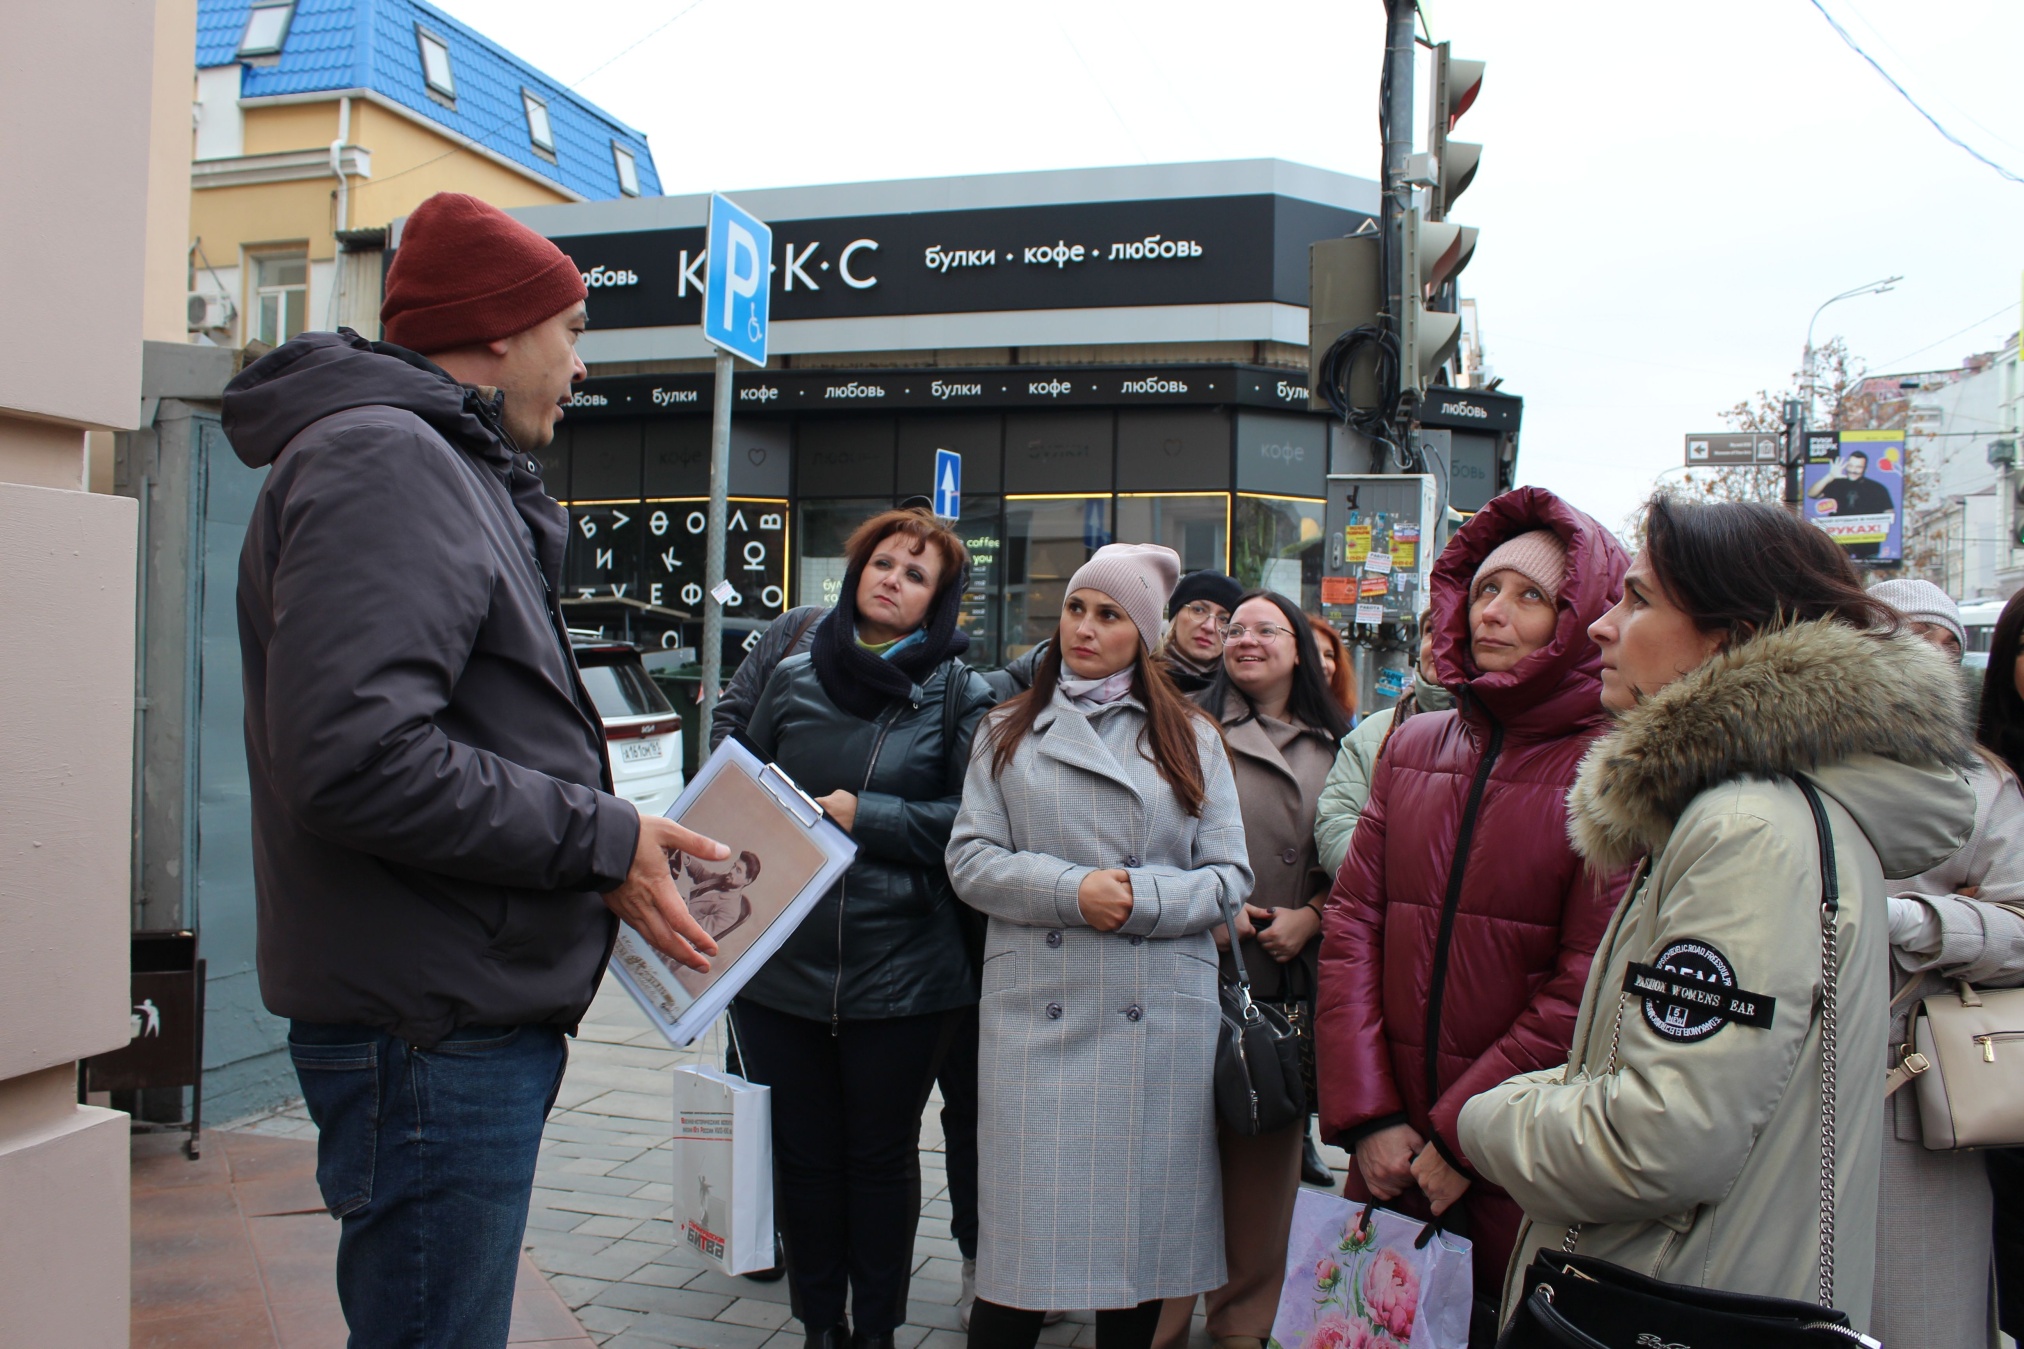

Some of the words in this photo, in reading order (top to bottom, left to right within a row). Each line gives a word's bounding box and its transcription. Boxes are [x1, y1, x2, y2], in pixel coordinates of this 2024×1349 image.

[925, 245, 996, 273] булки
[1024, 240, 1085, 268] кофе
[1108, 234, 1202, 261] любовь
[652, 387, 697, 403] булки
[740, 385, 778, 403] кофе
[825, 382, 885, 399] любовь
[931, 380, 981, 399] булки
[1028, 378, 1071, 397] кофе
[1121, 376, 1188, 394] любовь
[1441, 402, 1488, 419] любовь
[1261, 440, 1304, 466] кофе
[966, 537, 1000, 548] coffee
[973, 555, 993, 566] you
[1672, 984, 1721, 1007] WOMENS
[1668, 1015, 1685, 1025] NEW
[1673, 1008, 1680, 1017] 5
